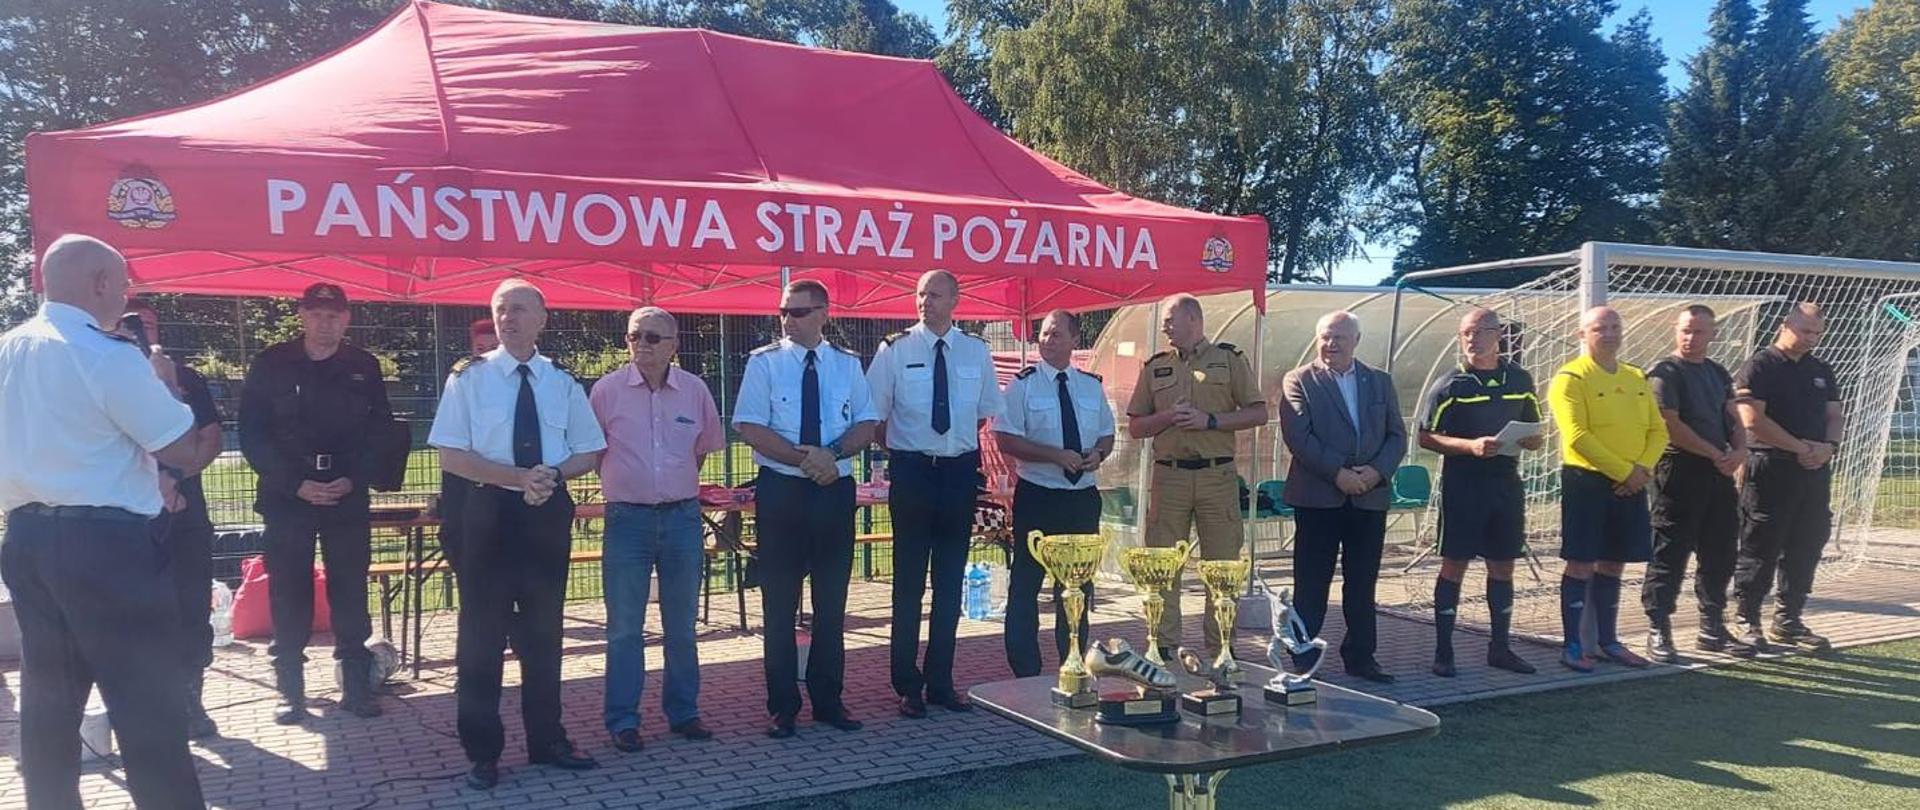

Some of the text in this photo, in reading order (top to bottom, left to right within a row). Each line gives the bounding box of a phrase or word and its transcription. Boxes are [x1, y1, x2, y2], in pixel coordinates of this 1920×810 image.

[267, 173, 1159, 270] PAŃSTWOWA STRAŻ POŻARNA
